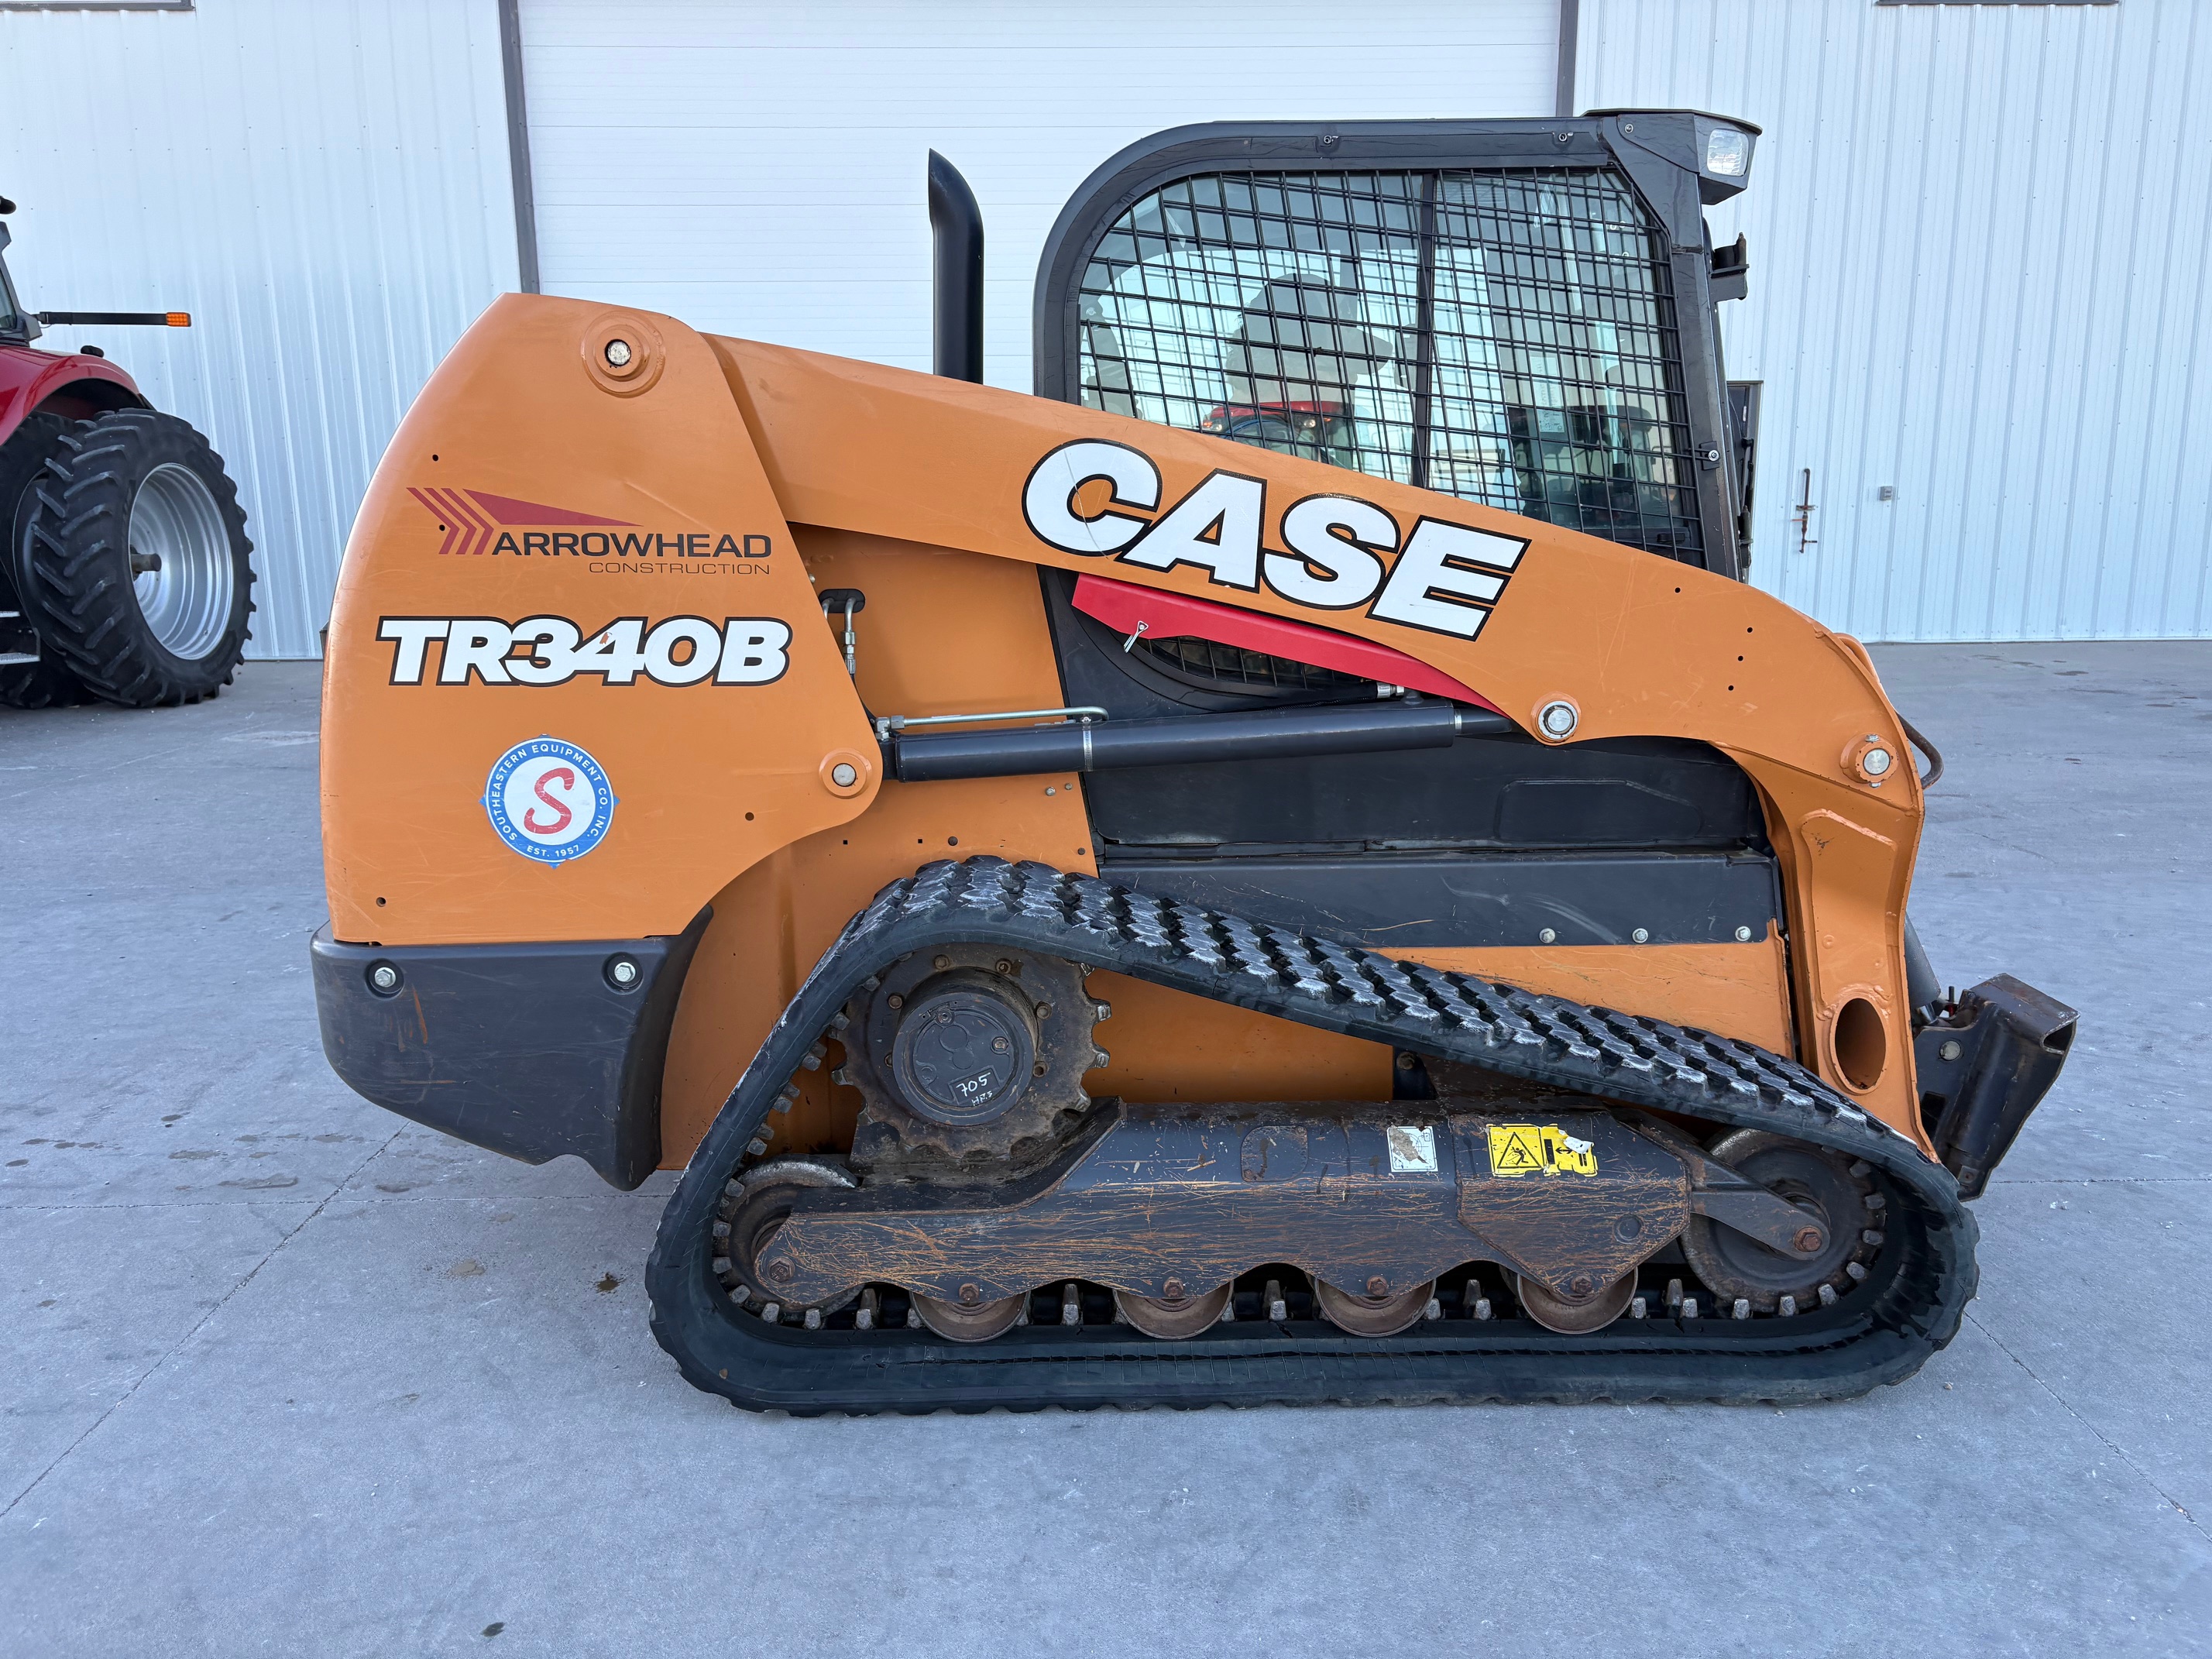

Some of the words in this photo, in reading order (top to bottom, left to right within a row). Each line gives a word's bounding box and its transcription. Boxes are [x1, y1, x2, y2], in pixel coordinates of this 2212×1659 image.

[492, 531, 771, 558] ARROWHEAD
[1022, 438, 1532, 641] CASE
[589, 562, 771, 575] CONSTRUCTION
[376, 615, 792, 686] TR340B
[531, 744, 603, 782] EQUIPMENT
[491, 748, 527, 841] SOUTHEASTERN
[524, 767, 575, 835] S
[597, 787, 609, 809] CO.
[586, 814, 606, 838] INC.
[526, 844, 550, 857] EST.
[555, 844, 580, 857] 1957
[955, 1072, 991, 1097] 705
